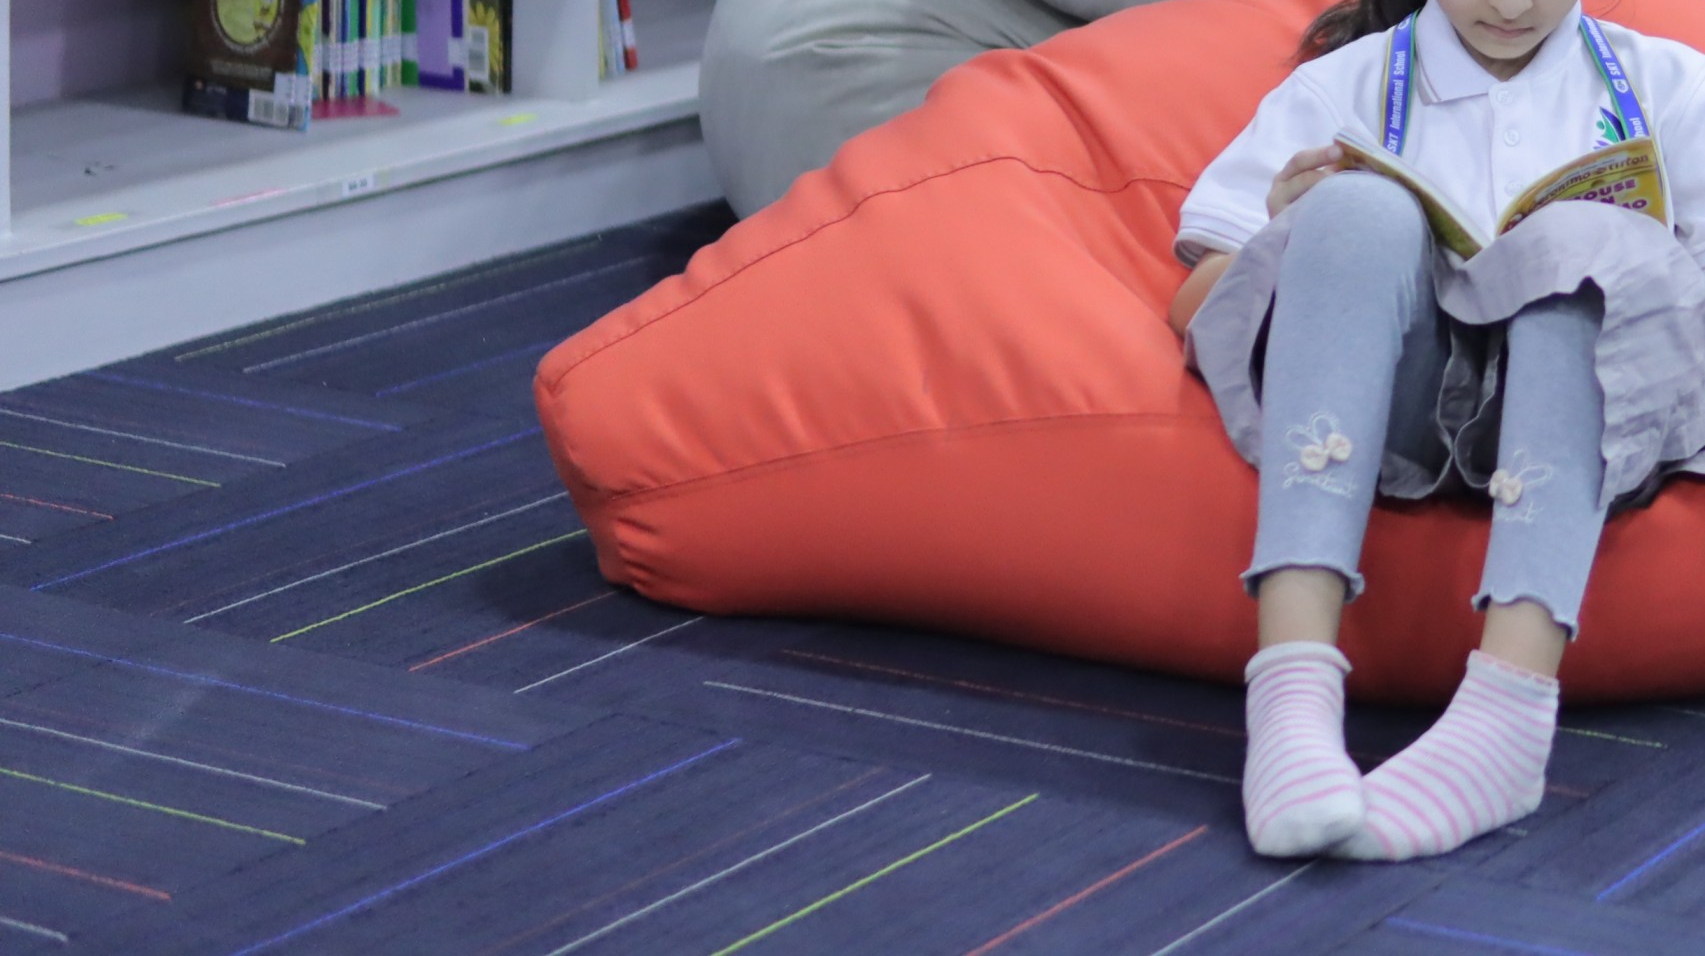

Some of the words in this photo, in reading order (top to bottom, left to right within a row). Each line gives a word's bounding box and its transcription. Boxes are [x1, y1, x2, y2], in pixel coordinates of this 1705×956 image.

[1393, 50, 1406, 76] School
[1605, 60, 1621, 76] SKT
[1390, 79, 1405, 131] International
[1629, 117, 1646, 138] hool
[1387, 132, 1399, 154] SKT
[1574, 179, 1637, 200] OUSE
